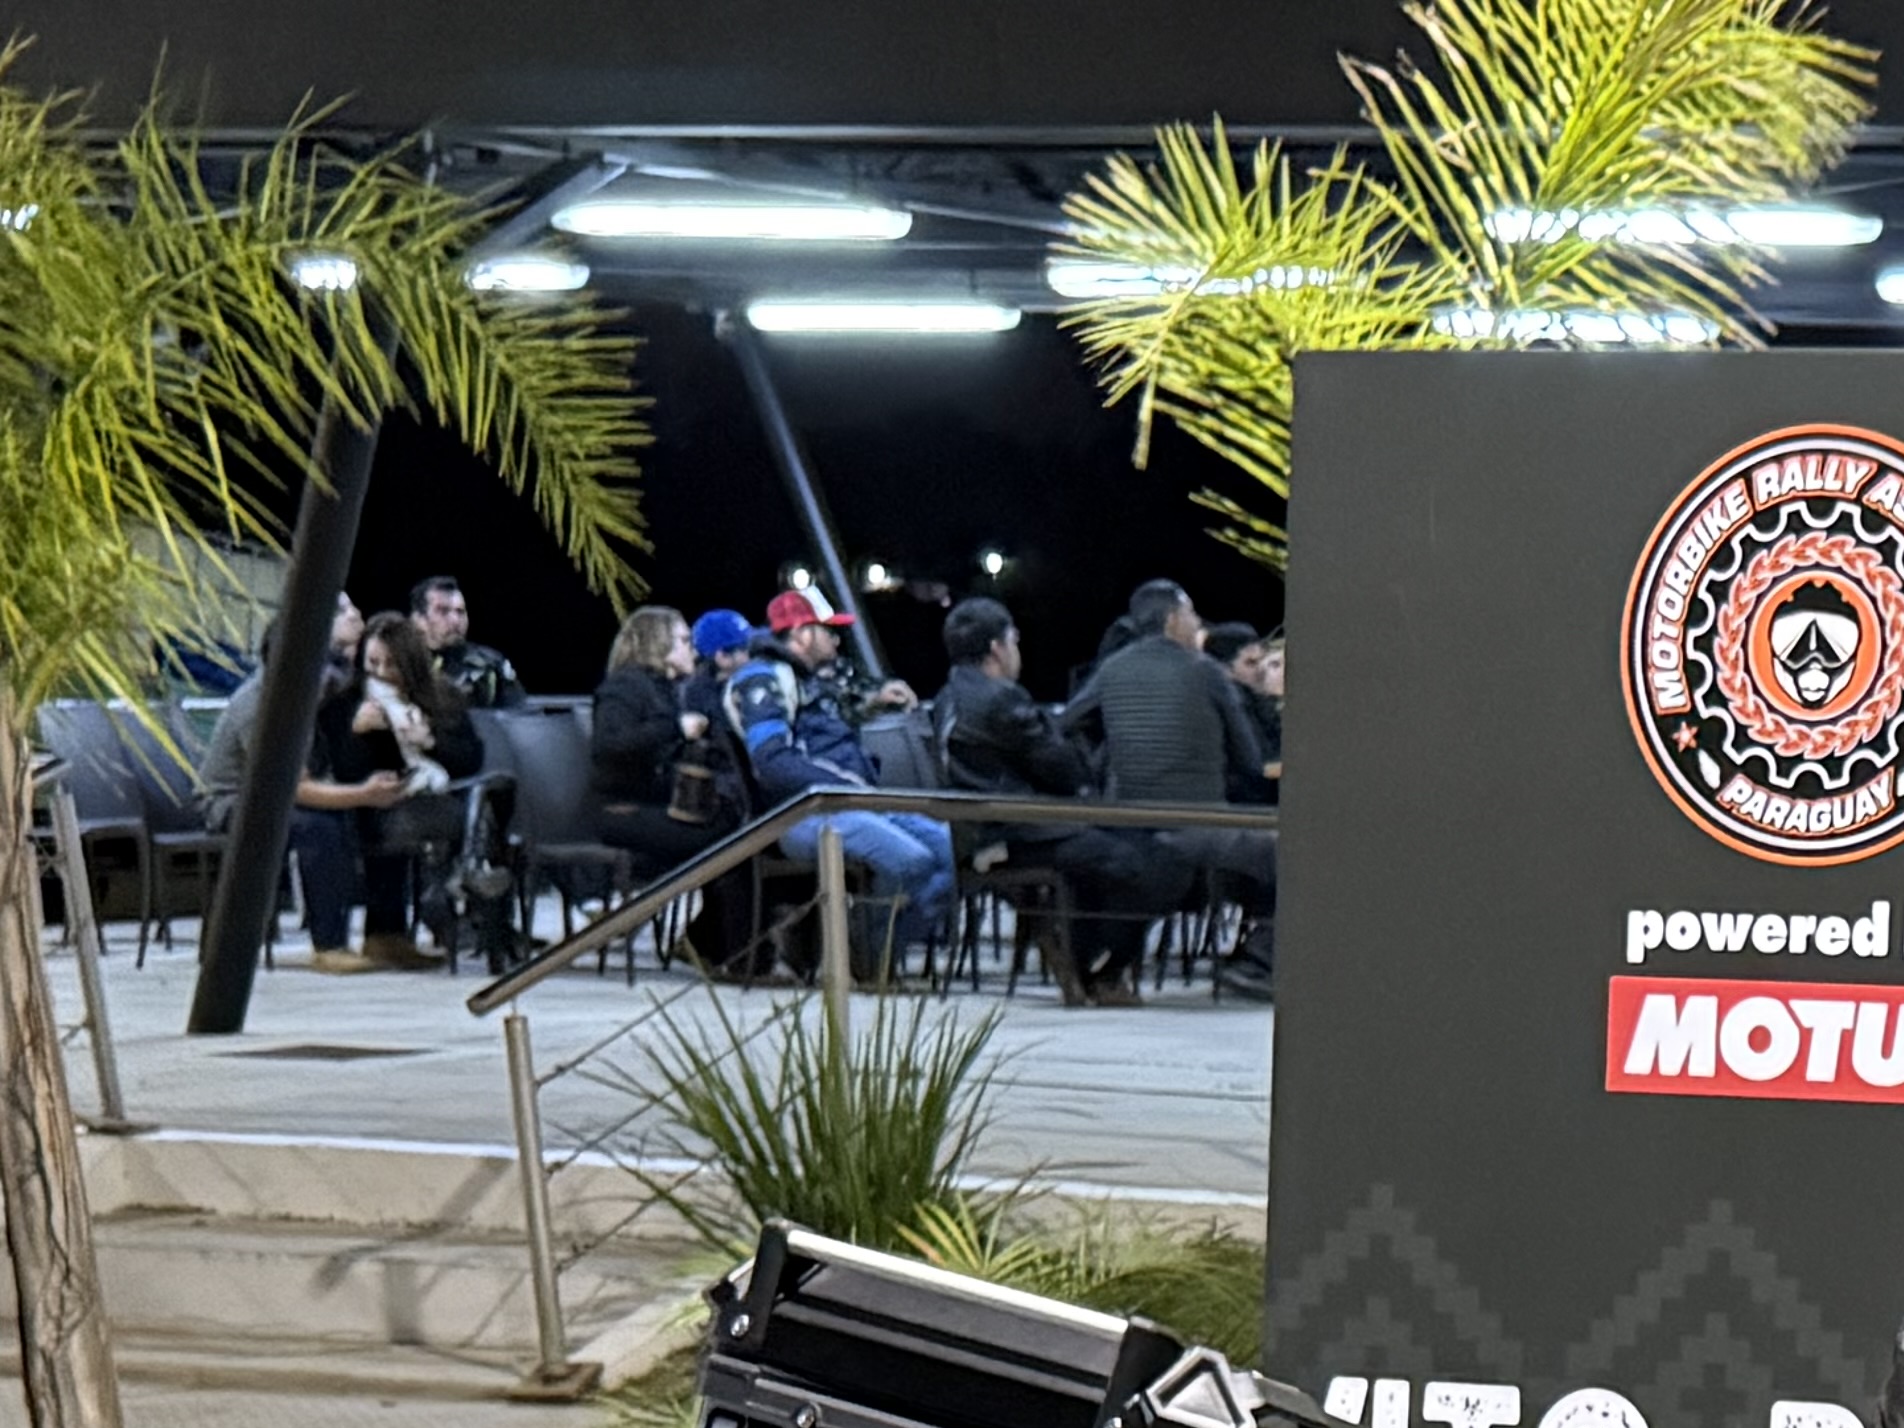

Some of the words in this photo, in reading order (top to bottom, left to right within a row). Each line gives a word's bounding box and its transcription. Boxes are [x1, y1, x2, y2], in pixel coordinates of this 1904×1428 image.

[1650, 482, 1750, 711] MOTORBIKE
[1756, 456, 1870, 501] RALLY
[1722, 776, 1893, 833] PARAGUAY
[1626, 901, 1890, 964] powered
